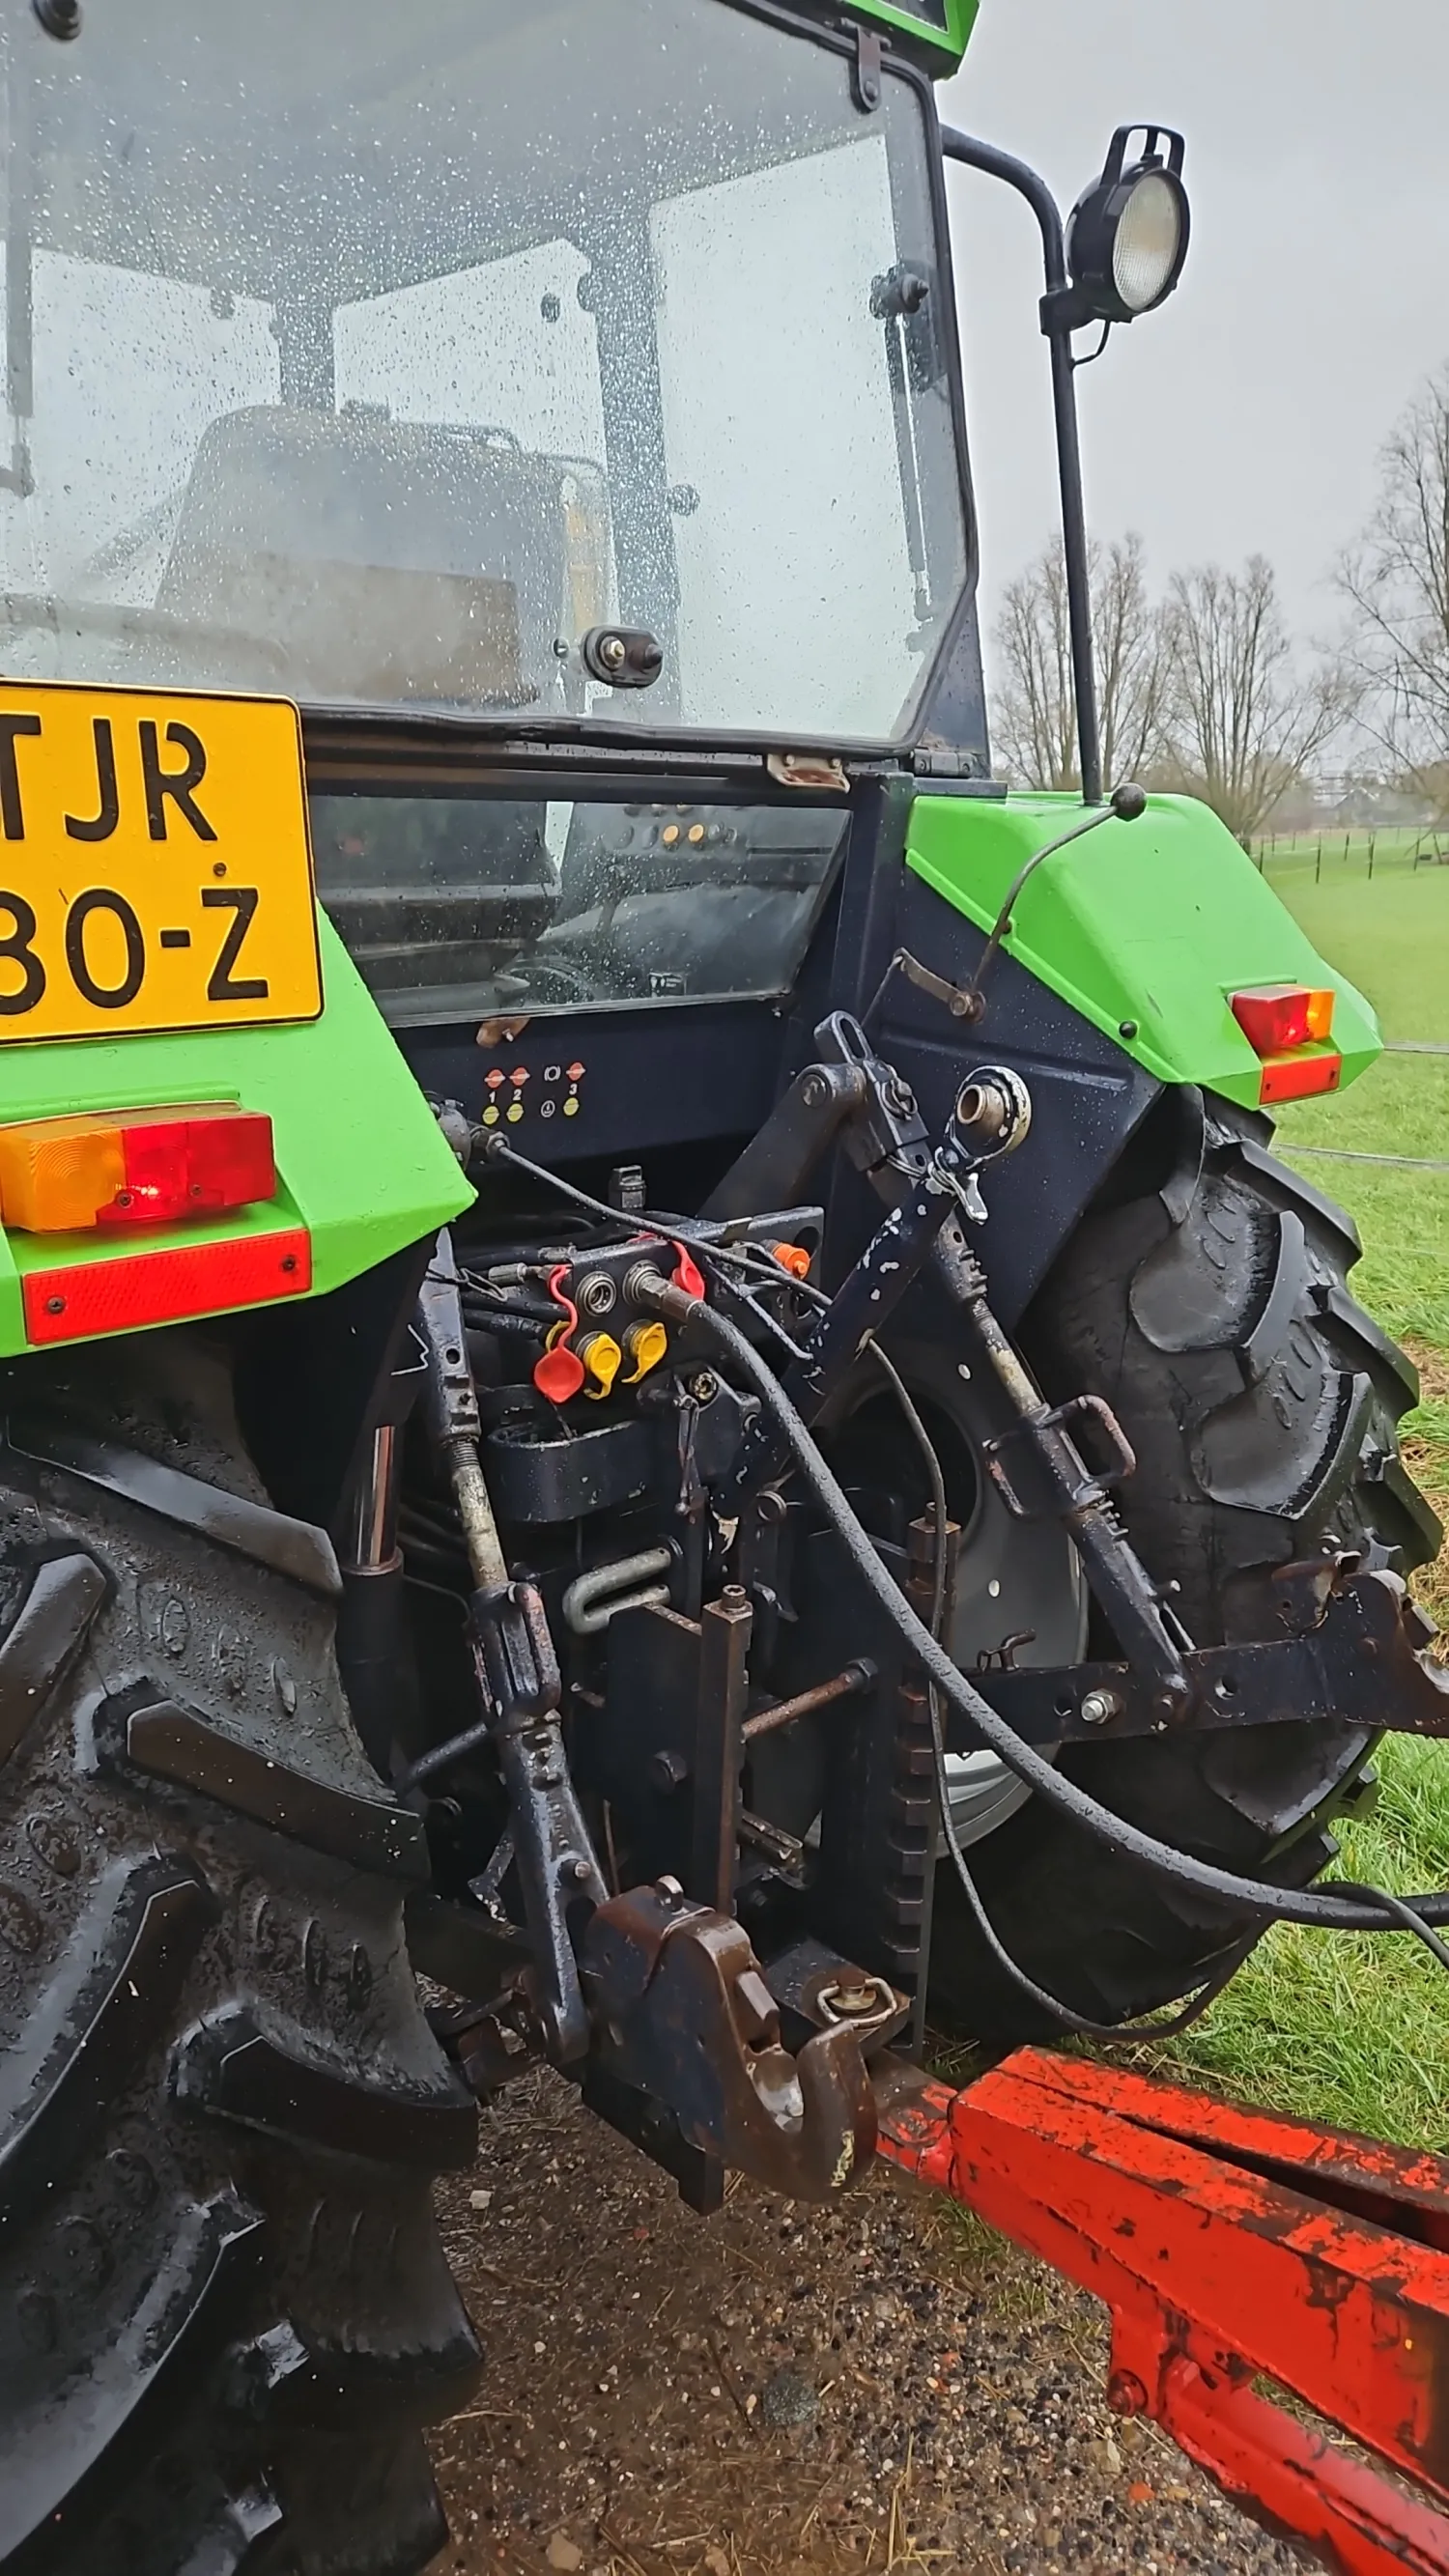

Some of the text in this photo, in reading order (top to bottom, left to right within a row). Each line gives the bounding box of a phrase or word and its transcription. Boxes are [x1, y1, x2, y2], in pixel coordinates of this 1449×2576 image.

[0, 714, 218, 842] TJR
[489, 1083, 578, 1104] 1 2 3
